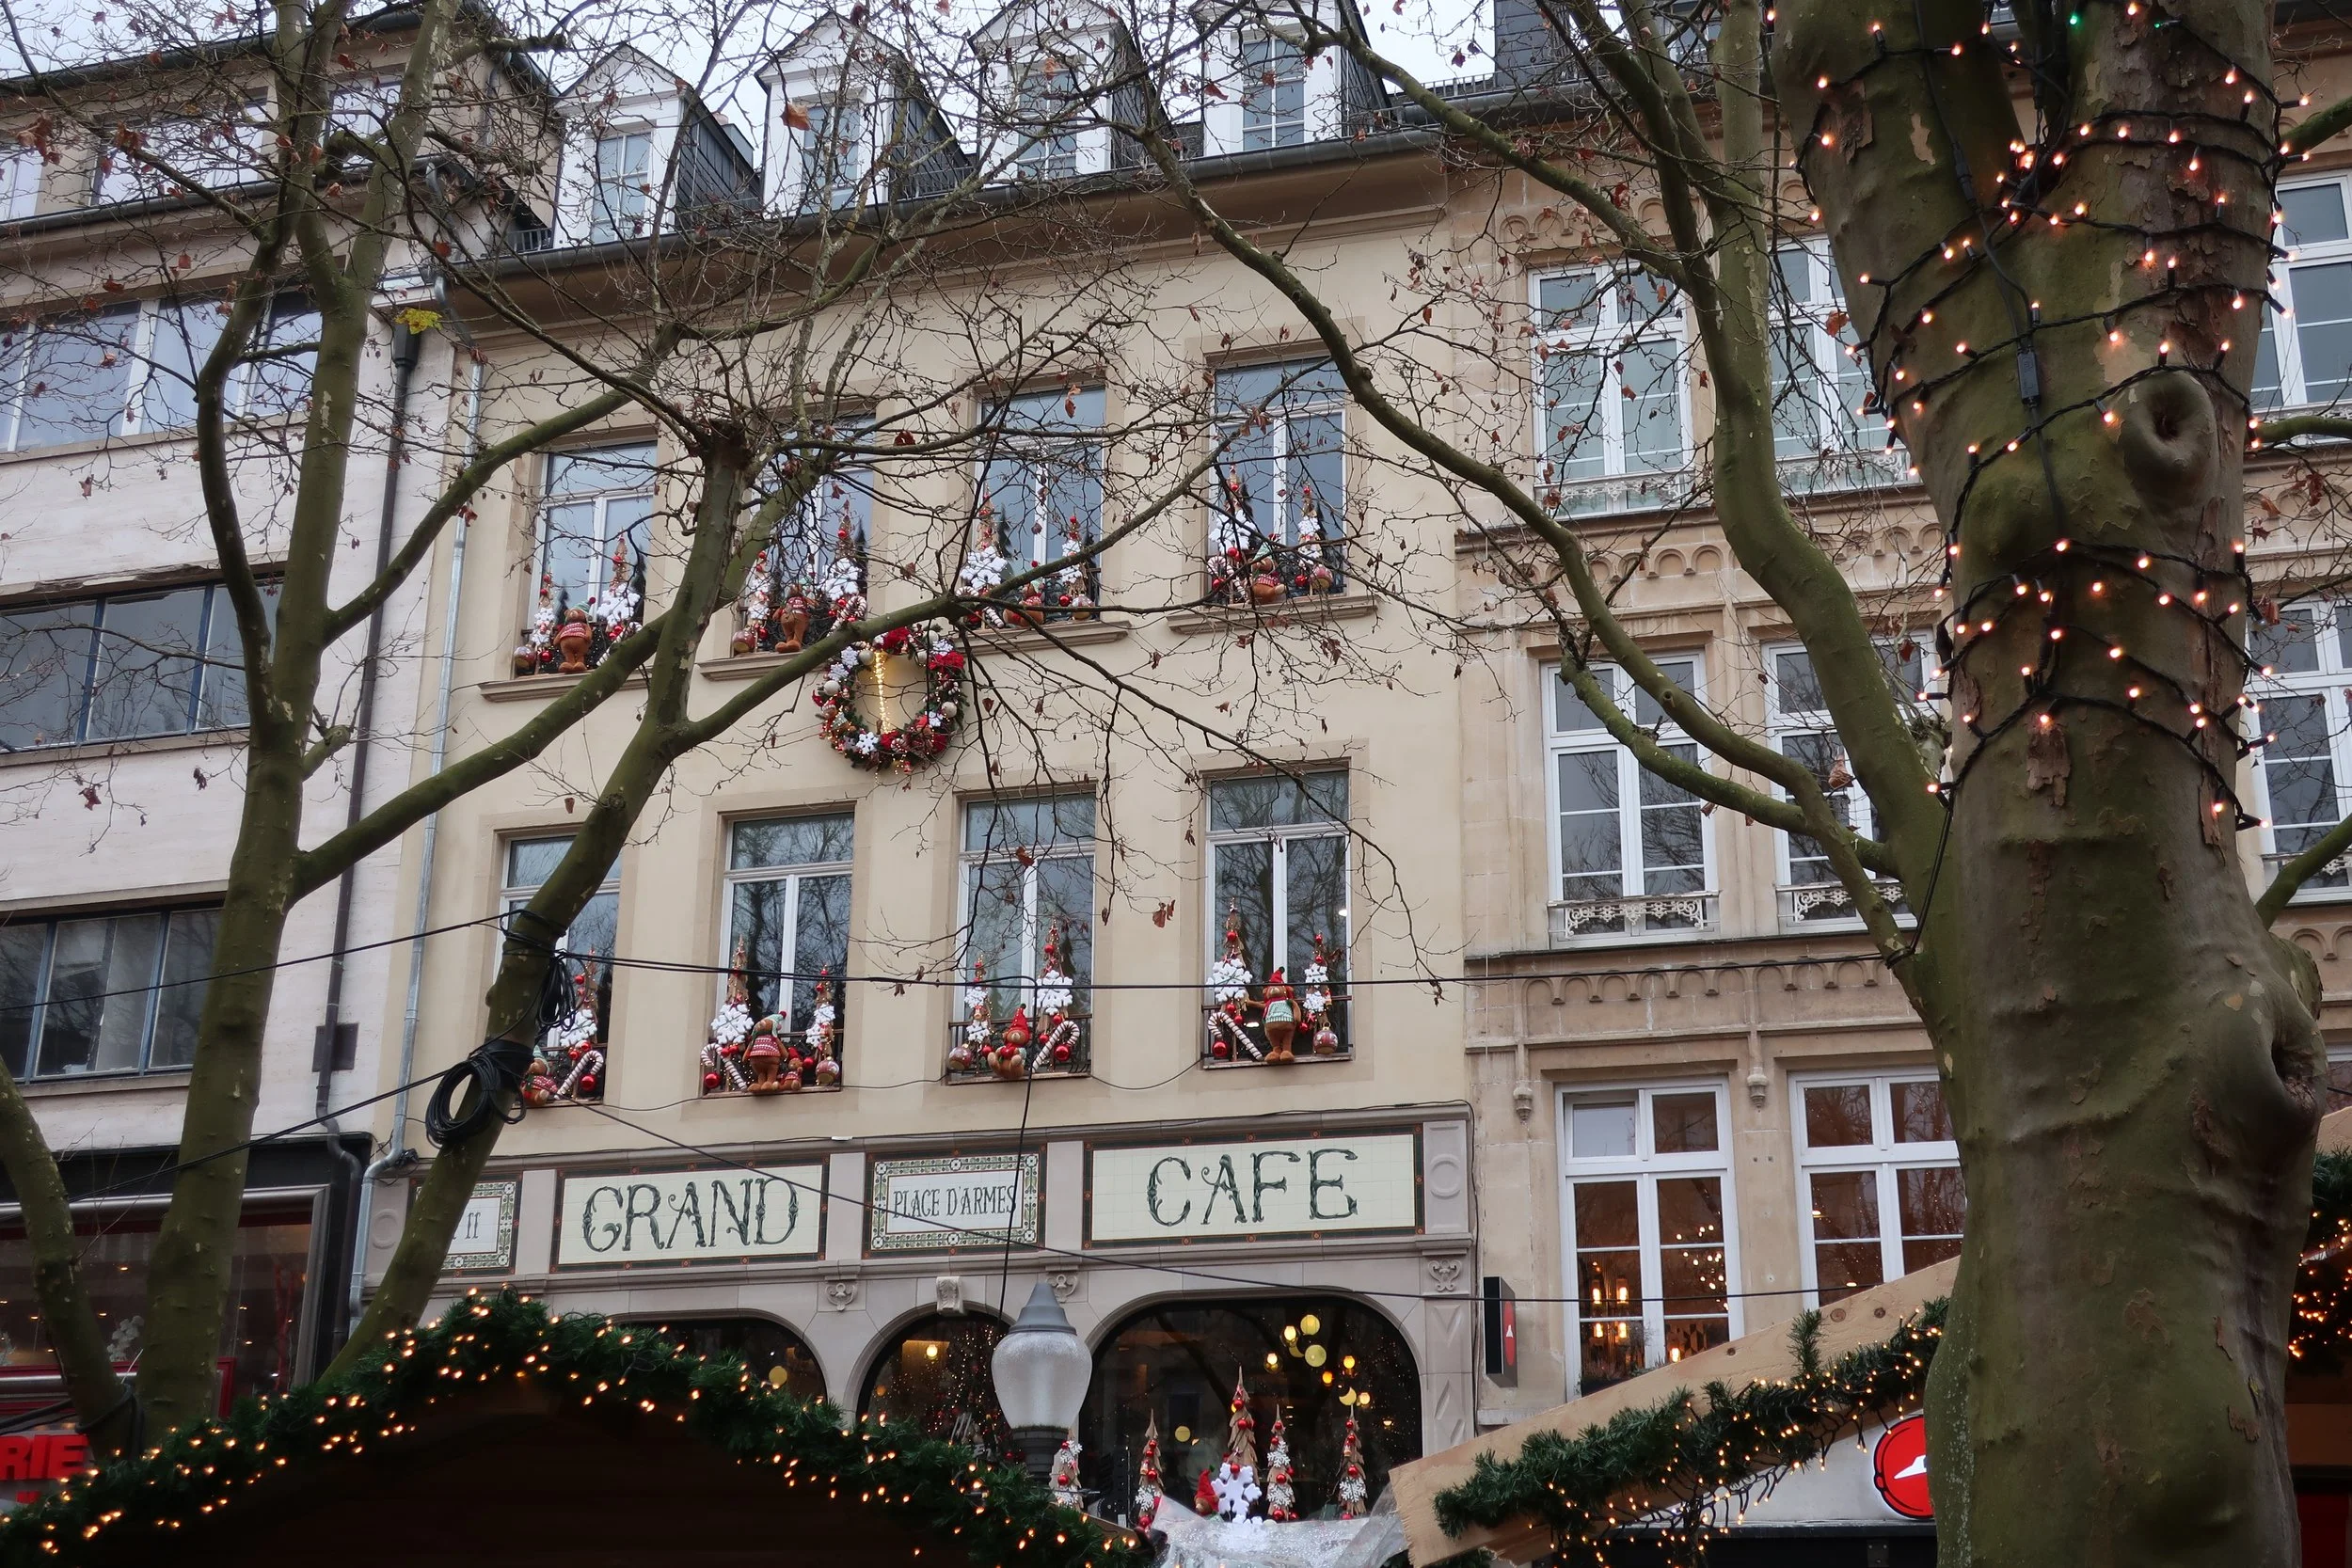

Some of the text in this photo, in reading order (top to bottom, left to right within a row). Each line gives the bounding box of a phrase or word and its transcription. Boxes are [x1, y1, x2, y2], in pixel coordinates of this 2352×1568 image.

[582, 1178, 799, 1253] GRAND
[893, 1185, 1017, 1219] PLACE D'ARMES
[1147, 1148, 1359, 1227] CAFE
